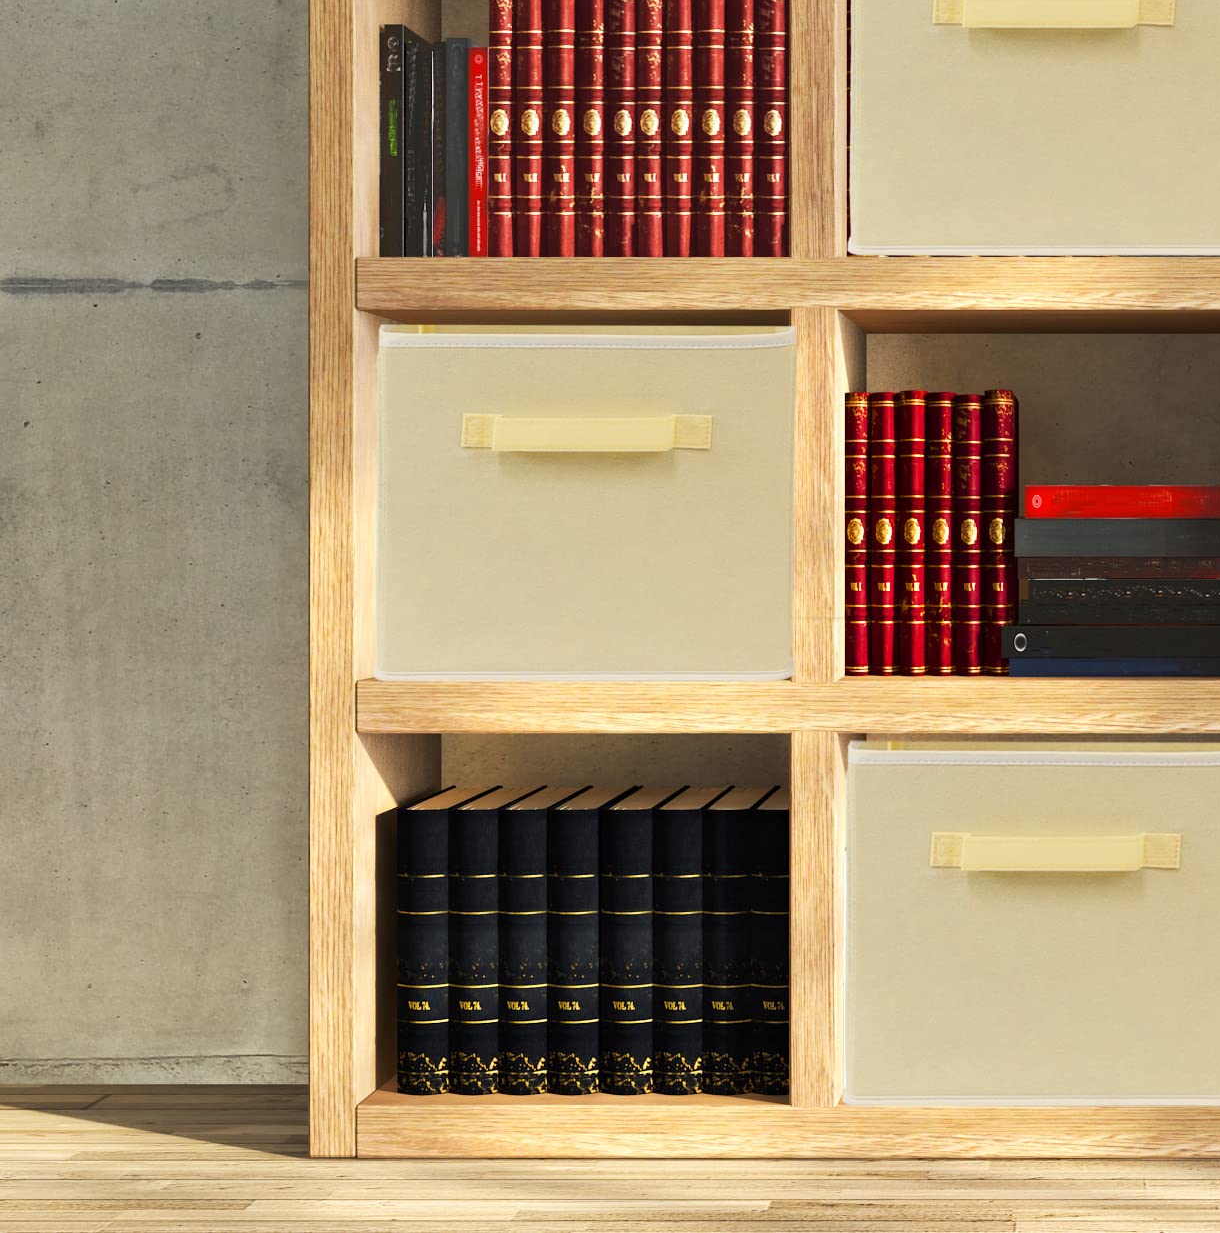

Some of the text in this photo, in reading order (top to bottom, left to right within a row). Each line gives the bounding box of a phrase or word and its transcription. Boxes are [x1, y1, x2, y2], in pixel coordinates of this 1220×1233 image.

[408, 1001, 422, 1010] VOL
[459, 1001, 473, 1010] VOL
[507, 1001, 521, 1010] VOL
[559, 1001, 572, 1010] VOL
[613, 1001, 626, 1010] VOL
[664, 1001, 678, 1010] VOL
[712, 1001, 725, 1010] VOL
[763, 1001, 776, 1010] VOL
